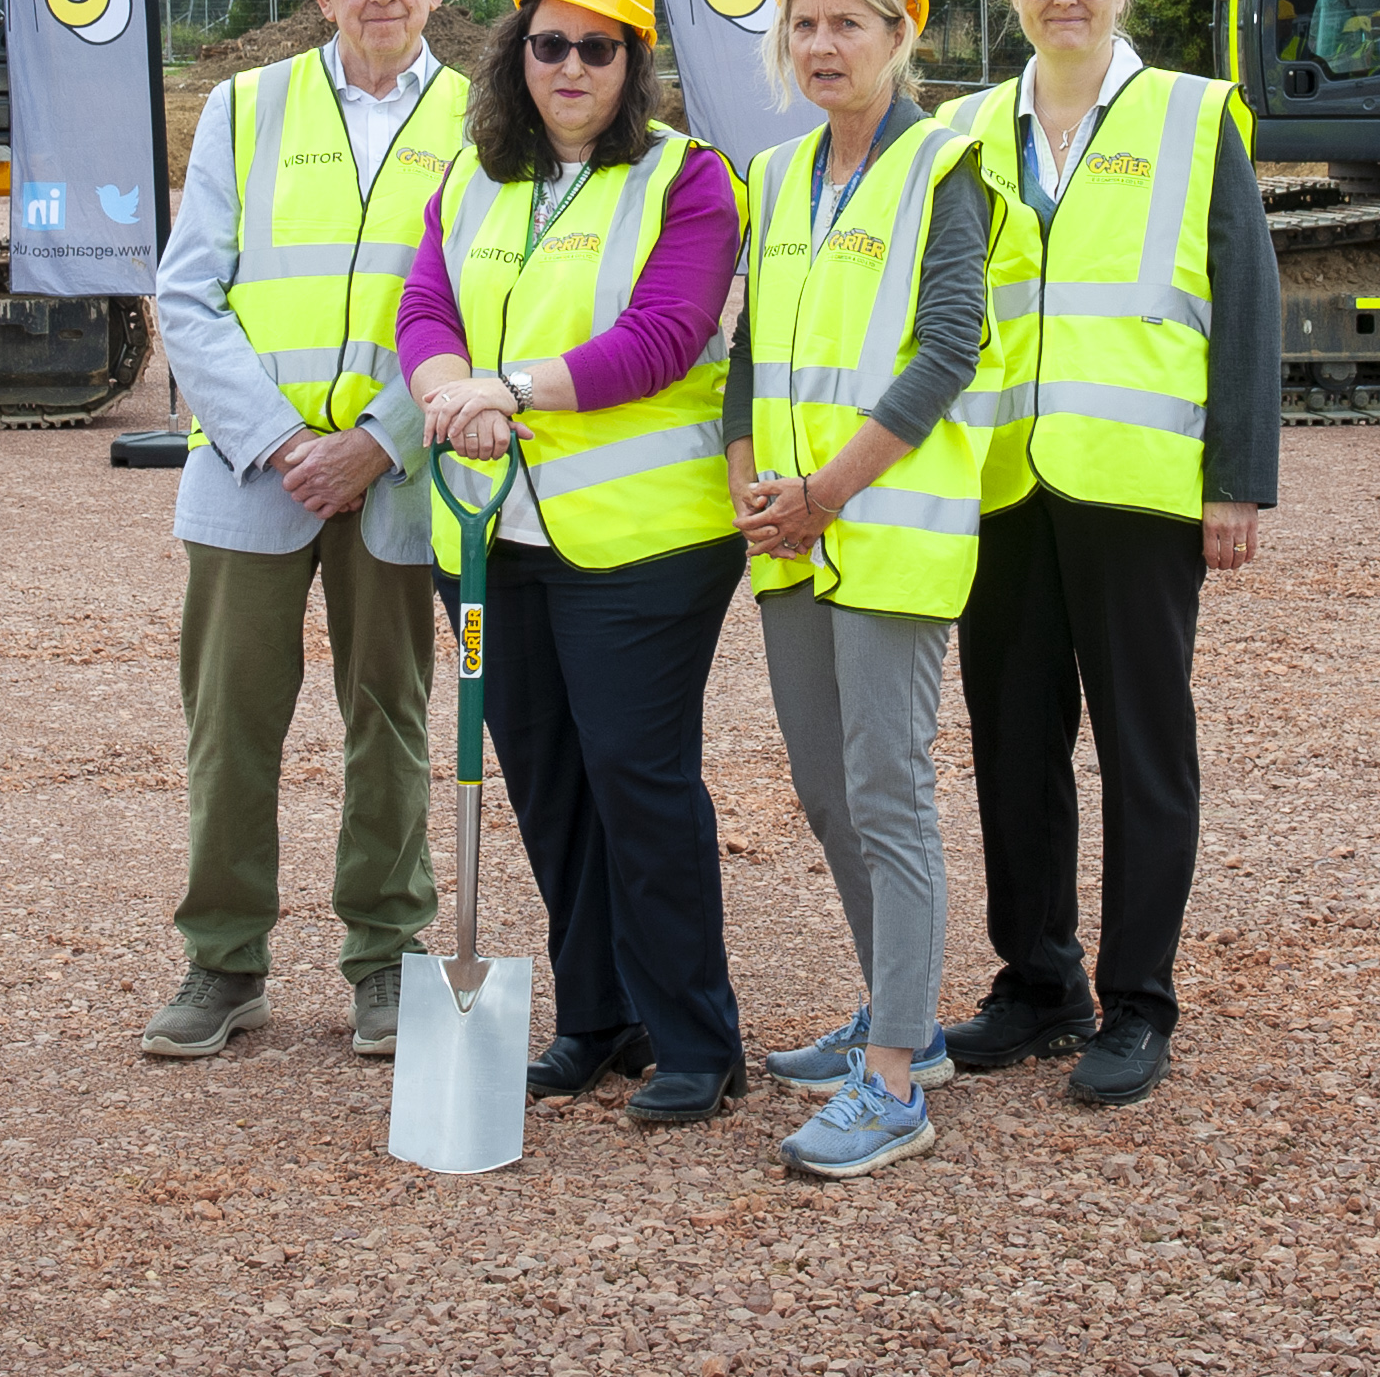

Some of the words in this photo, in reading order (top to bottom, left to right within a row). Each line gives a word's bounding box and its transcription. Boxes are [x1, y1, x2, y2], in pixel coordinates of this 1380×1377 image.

[284, 151, 343, 168] VISITOR
[1086, 152, 1152, 178] CARTER
[542, 232, 601, 254] CARTER
[763, 243, 807, 258] VISITOR
[827, 228, 886, 260] CARTER
[470, 248, 524, 267] VISITOR
[462, 608, 482, 675] CARTER
